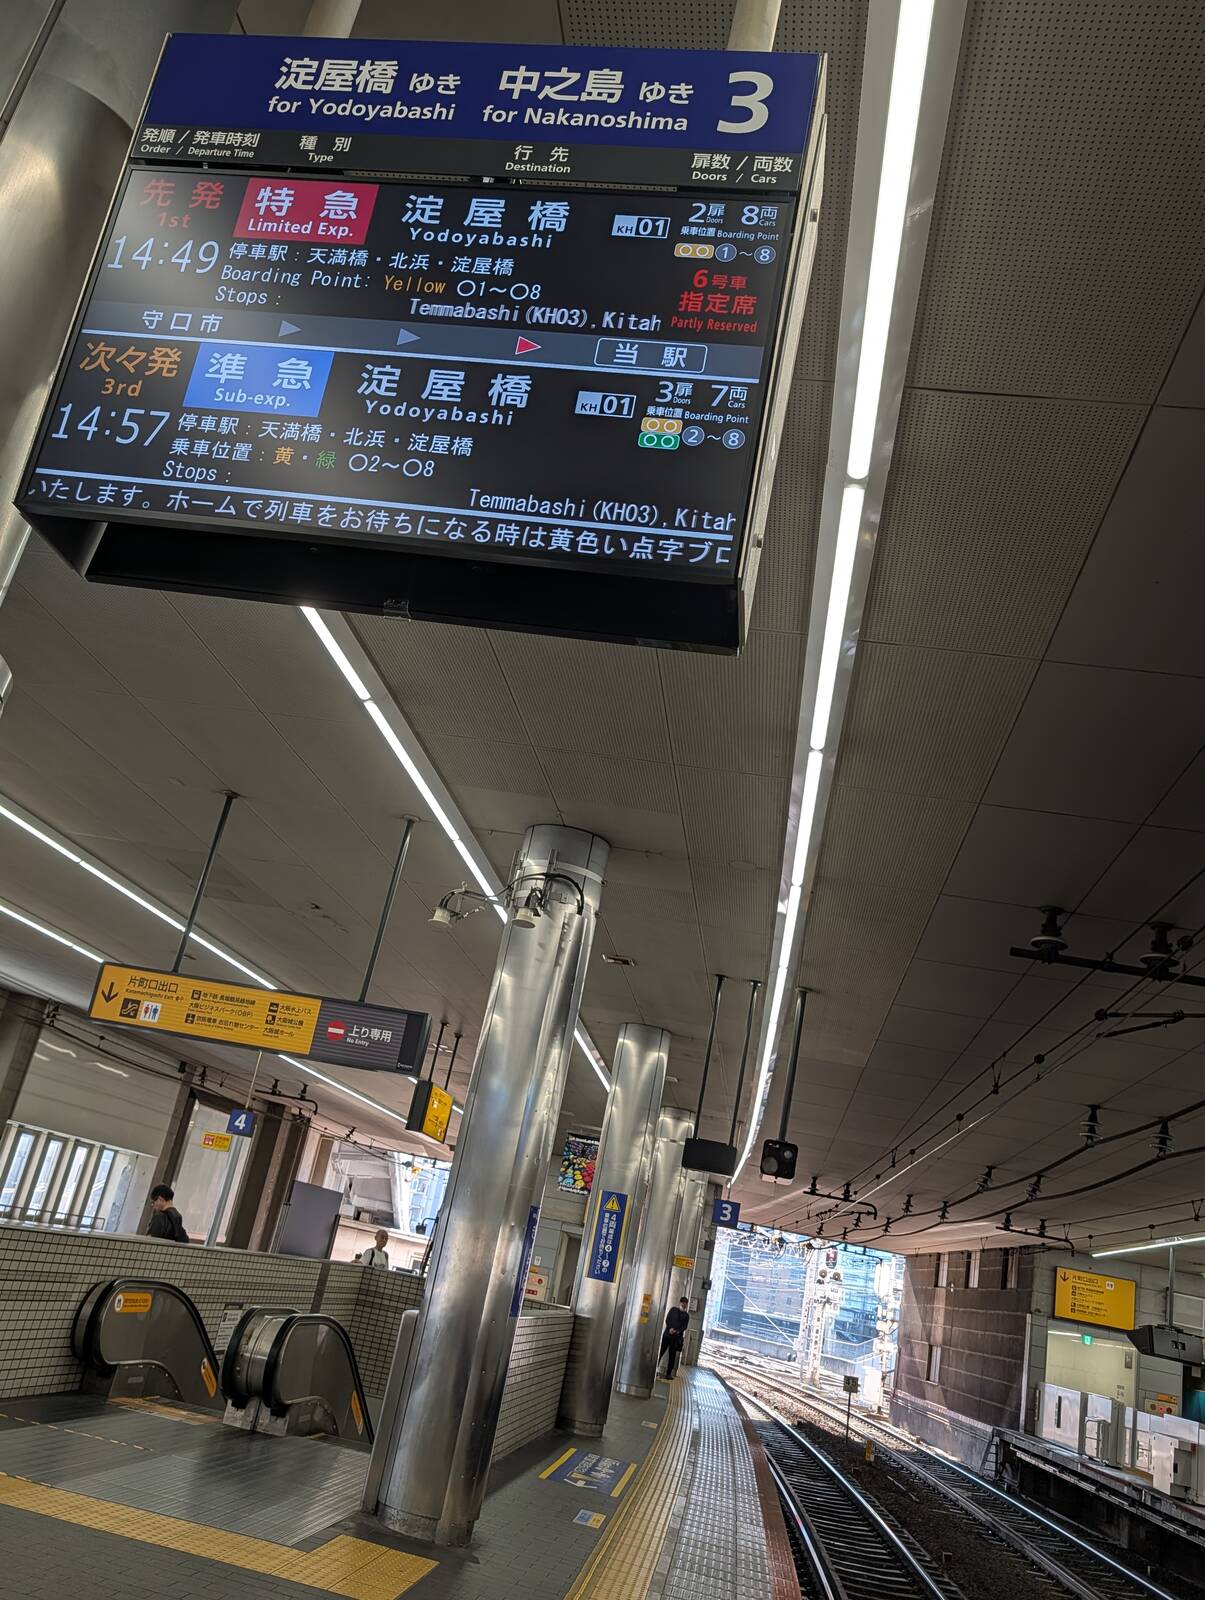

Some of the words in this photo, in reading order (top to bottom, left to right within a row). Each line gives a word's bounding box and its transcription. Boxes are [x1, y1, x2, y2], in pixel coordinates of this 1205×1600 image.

[274, 57, 399, 95] 淀屋橋
[408, 72, 462, 96] ゆき
[499, 65, 625, 104] 中之島
[638, 81, 695, 105] ゆき
[267, 96, 302, 114] for
[308, 98, 456, 121] Yodoyabashi
[716, 71, 774, 135] 3
[482, 105, 518, 124] for
[523, 107, 689, 132] Nakanoshima
[193, 130, 260, 148] 発車時刻
[140, 144, 171, 155] Order
[187, 147, 231, 160] Departure
[233, 149, 255, 159] Time
[308, 152, 334, 164] Type
[505, 162, 572, 174] Destination
[691, 153, 731, 171] 扉数
[753, 155, 794, 174] 両数
[692, 171, 728, 183] Doors
[750, 174, 778, 185] Cars
[254, 186, 360, 220] 特急
[401, 194, 571, 233] 淀屋橋
[156, 212, 192, 230] 1st
[247, 218, 312, 235] Limited
[317, 224, 355, 239] Exp.
[758, 219, 777, 227] Cars
[408, 226, 553, 249] Yodoyabashi
[717, 229, 755, 241] Boarding
[757, 231, 780, 241] Point
[106, 235, 220, 274] 14:49
[220, 264, 301, 287] Boarding
[311, 272, 372, 289] Point:
[384, 274, 448, 295] Yellow
[215, 285, 268, 306] Stops
[678, 290, 758, 316] 指定席
[409, 297, 520, 323] Temmabashi
[141, 310, 224, 333] 守口市
[671, 315, 704, 332] Partly
[706, 319, 758, 334] Reserved
[78, 341, 183, 378] 次々発
[613, 343, 689, 368] 当駅
[204, 352, 313, 391] 準急
[101, 378, 143, 398] 3rd
[356, 363, 533, 409] 淀屋橋
[213, 387, 291, 408] Sub-exp.
[727, 400, 746, 410] Cars
[364, 399, 513, 426] Yodoyabashi
[684, 410, 724, 424] Boarding
[725, 413, 750, 424] Point
[51, 402, 171, 447] 14:57
[162, 460, 218, 482] Stops
[468, 488, 586, 518] Temmabashi
[348, 1024, 393, 1043] 上り専用
[357, 1038, 370, 1047] Entry
[234, 1113, 247, 1130] 4
[719, 1204, 733, 1221] 3
